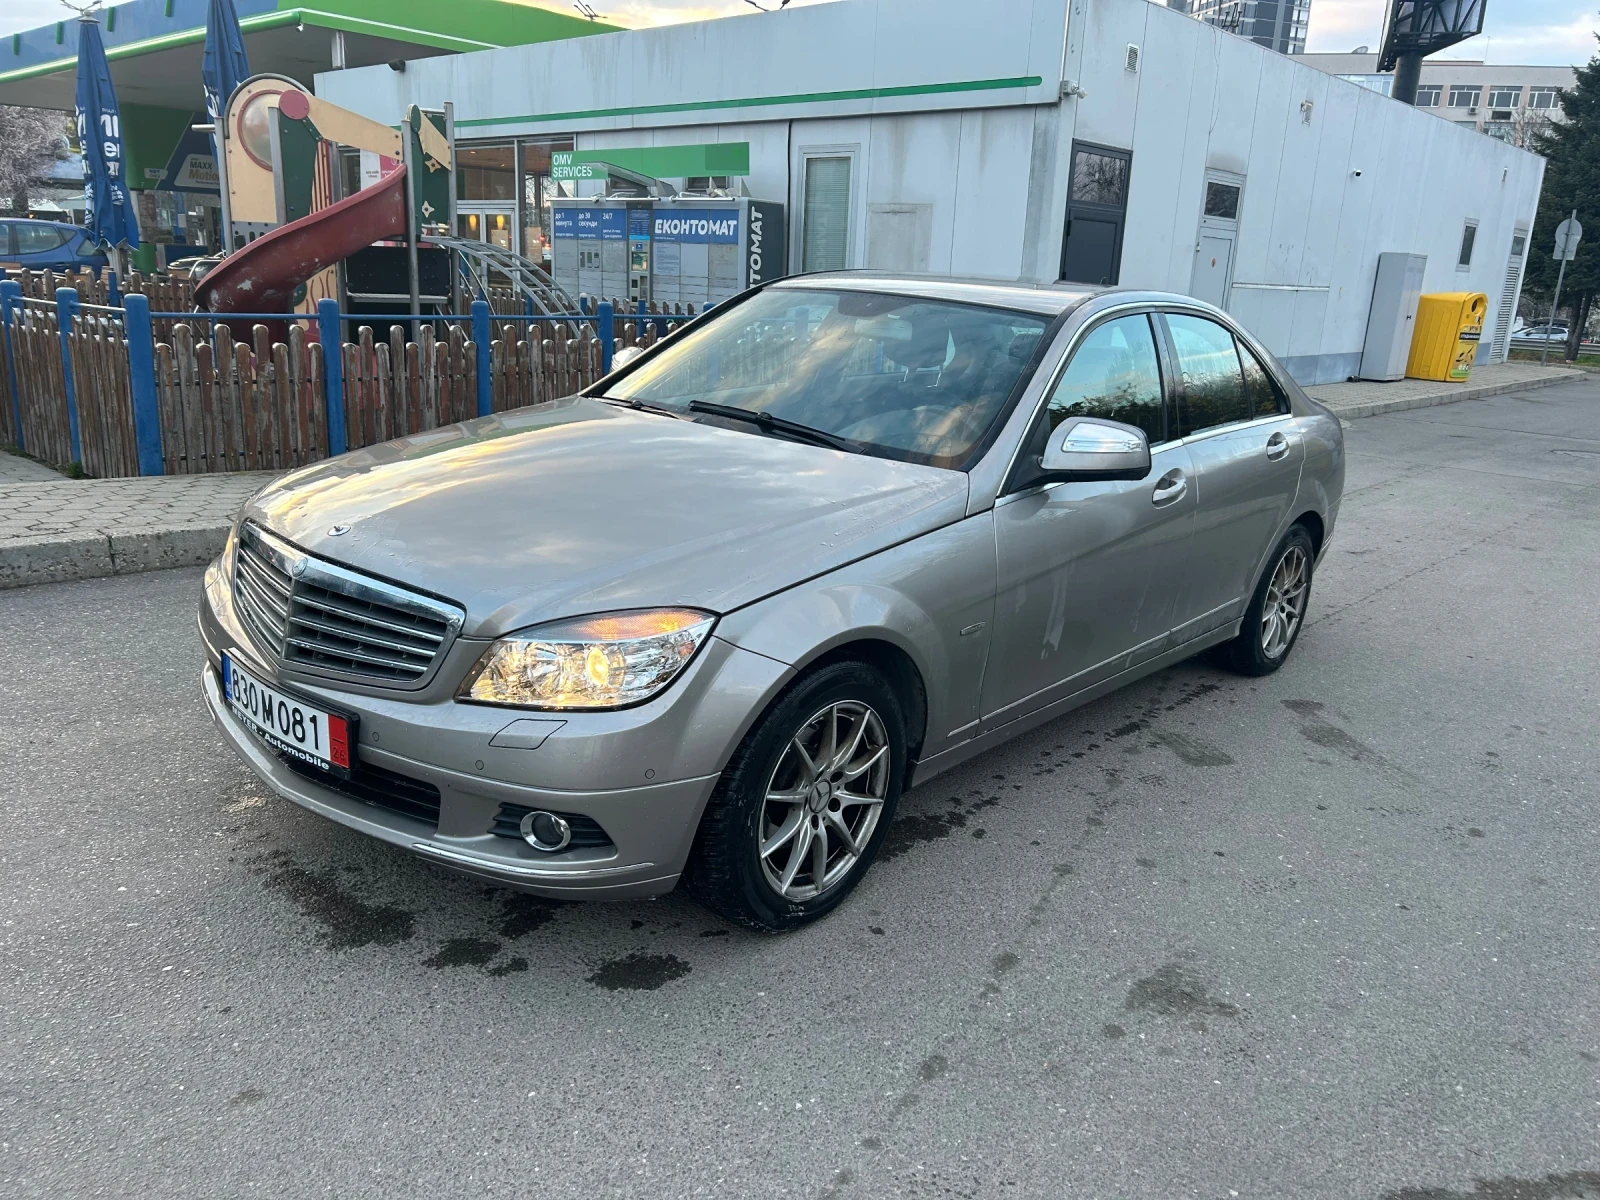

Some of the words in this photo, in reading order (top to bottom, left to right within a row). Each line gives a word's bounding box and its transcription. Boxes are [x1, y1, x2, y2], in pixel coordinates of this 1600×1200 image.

[553, 154, 572, 165] OMV
[190, 161, 212, 170] MAXX
[553, 166, 592, 178] SERVICES
[578, 221, 598, 229] секунди
[654, 219, 738, 236] ЕКОНТОМАТ
[264, 733, 329, 770] Automobile
